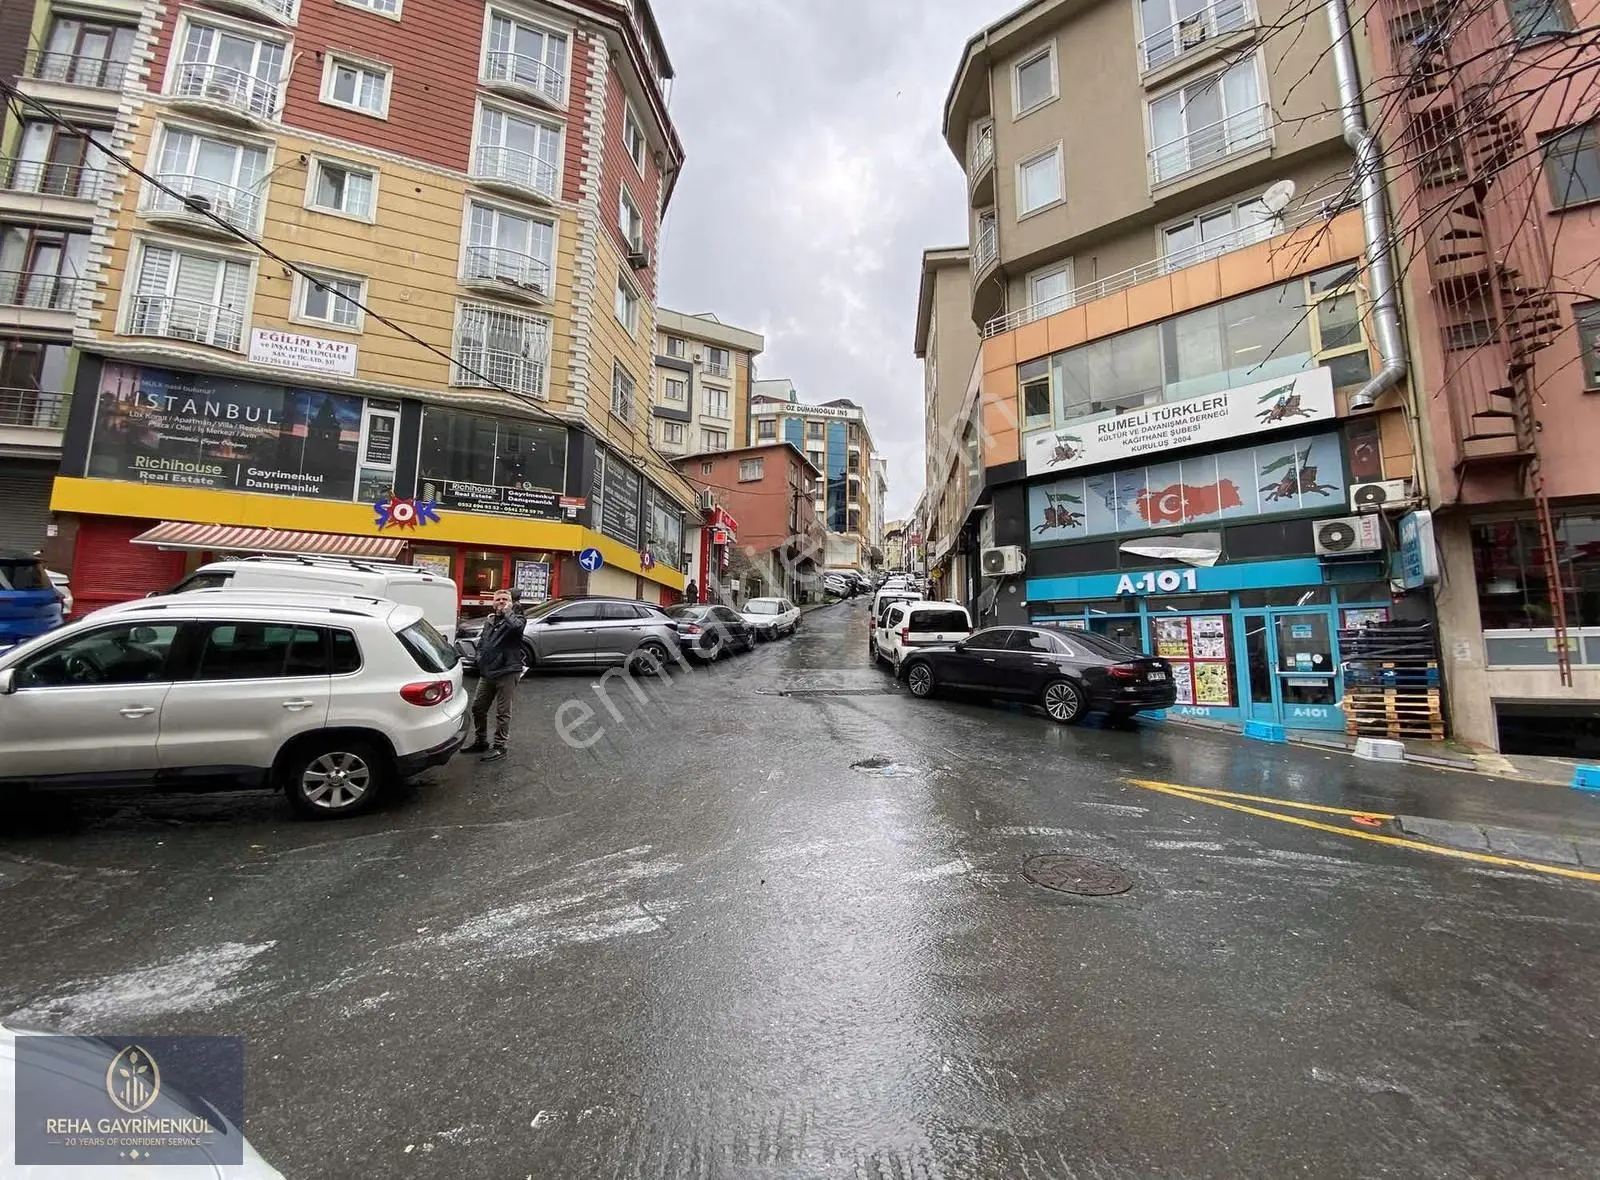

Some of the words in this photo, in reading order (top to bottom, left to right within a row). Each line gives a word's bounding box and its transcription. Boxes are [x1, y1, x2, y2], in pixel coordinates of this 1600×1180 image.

[259, 331, 311, 347] EĞİLİM
[316, 342, 349, 353] YAPI
[1097, 412, 1149, 434] RUMELİ
[1152, 394, 1228, 421] TÜRKLERİ
[1098, 430, 1128, 443] KÜLTÜR
[1129, 428, 1139, 436] VE
[1141, 418, 1188, 433] DAYANIŞMA
[1190, 409, 1229, 423] DERNEĞİ
[1131, 439, 1169, 453] KURULUŞ
[1173, 435, 1192, 445] 2004
[135, 455, 223, 475] Richihouse
[139, 471, 168, 481] Real
[172, 474, 215, 485] Estate
[247, 468, 324, 483] Gayrimenkul
[246, 479, 320, 494] Danışmanlık
